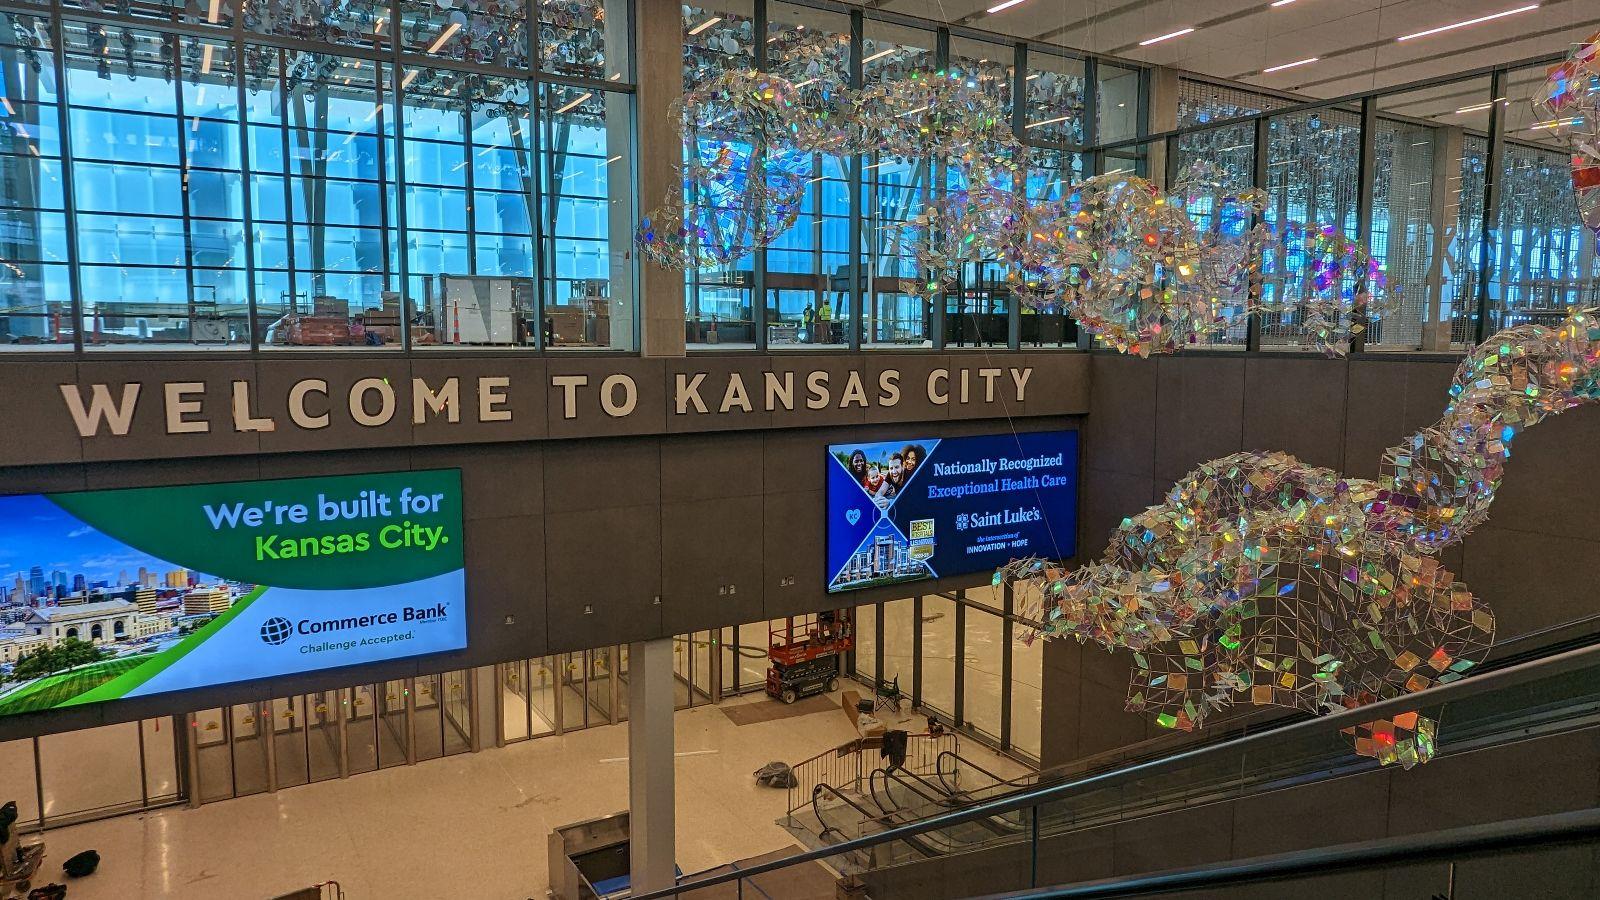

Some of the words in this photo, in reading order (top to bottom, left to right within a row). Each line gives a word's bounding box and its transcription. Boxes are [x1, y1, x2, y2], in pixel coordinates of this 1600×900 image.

[59, 376, 514, 438] WELCOME
[552, 374, 638, 419] TO
[674, 370, 901, 415] KANSAS
[926, 367, 1034, 405] CITY
[933, 459, 997, 476] Nationally
[999, 453, 1063, 471] Recognized
[927, 479, 998, 499] Exceptional
[1001, 475, 1039, 492] Health
[1041, 474, 1067, 487] Care
[203, 500, 309, 530] We're
[318, 490, 392, 521] built
[400, 487, 444, 515] for
[970, 510, 1001, 528] Saint
[912, 521, 933, 531] BEST
[255, 534, 370, 561] Kansas
[379, 520, 449, 551] City.
[966, 542, 1006, 554] INNOVATION
[1011, 539, 1029, 548] HOPE
[297, 612, 398, 635] Commerce
[403, 603, 447, 622] Bank
[299, 638, 357, 655] Challenge
[359, 630, 416, 646] Accepted.
